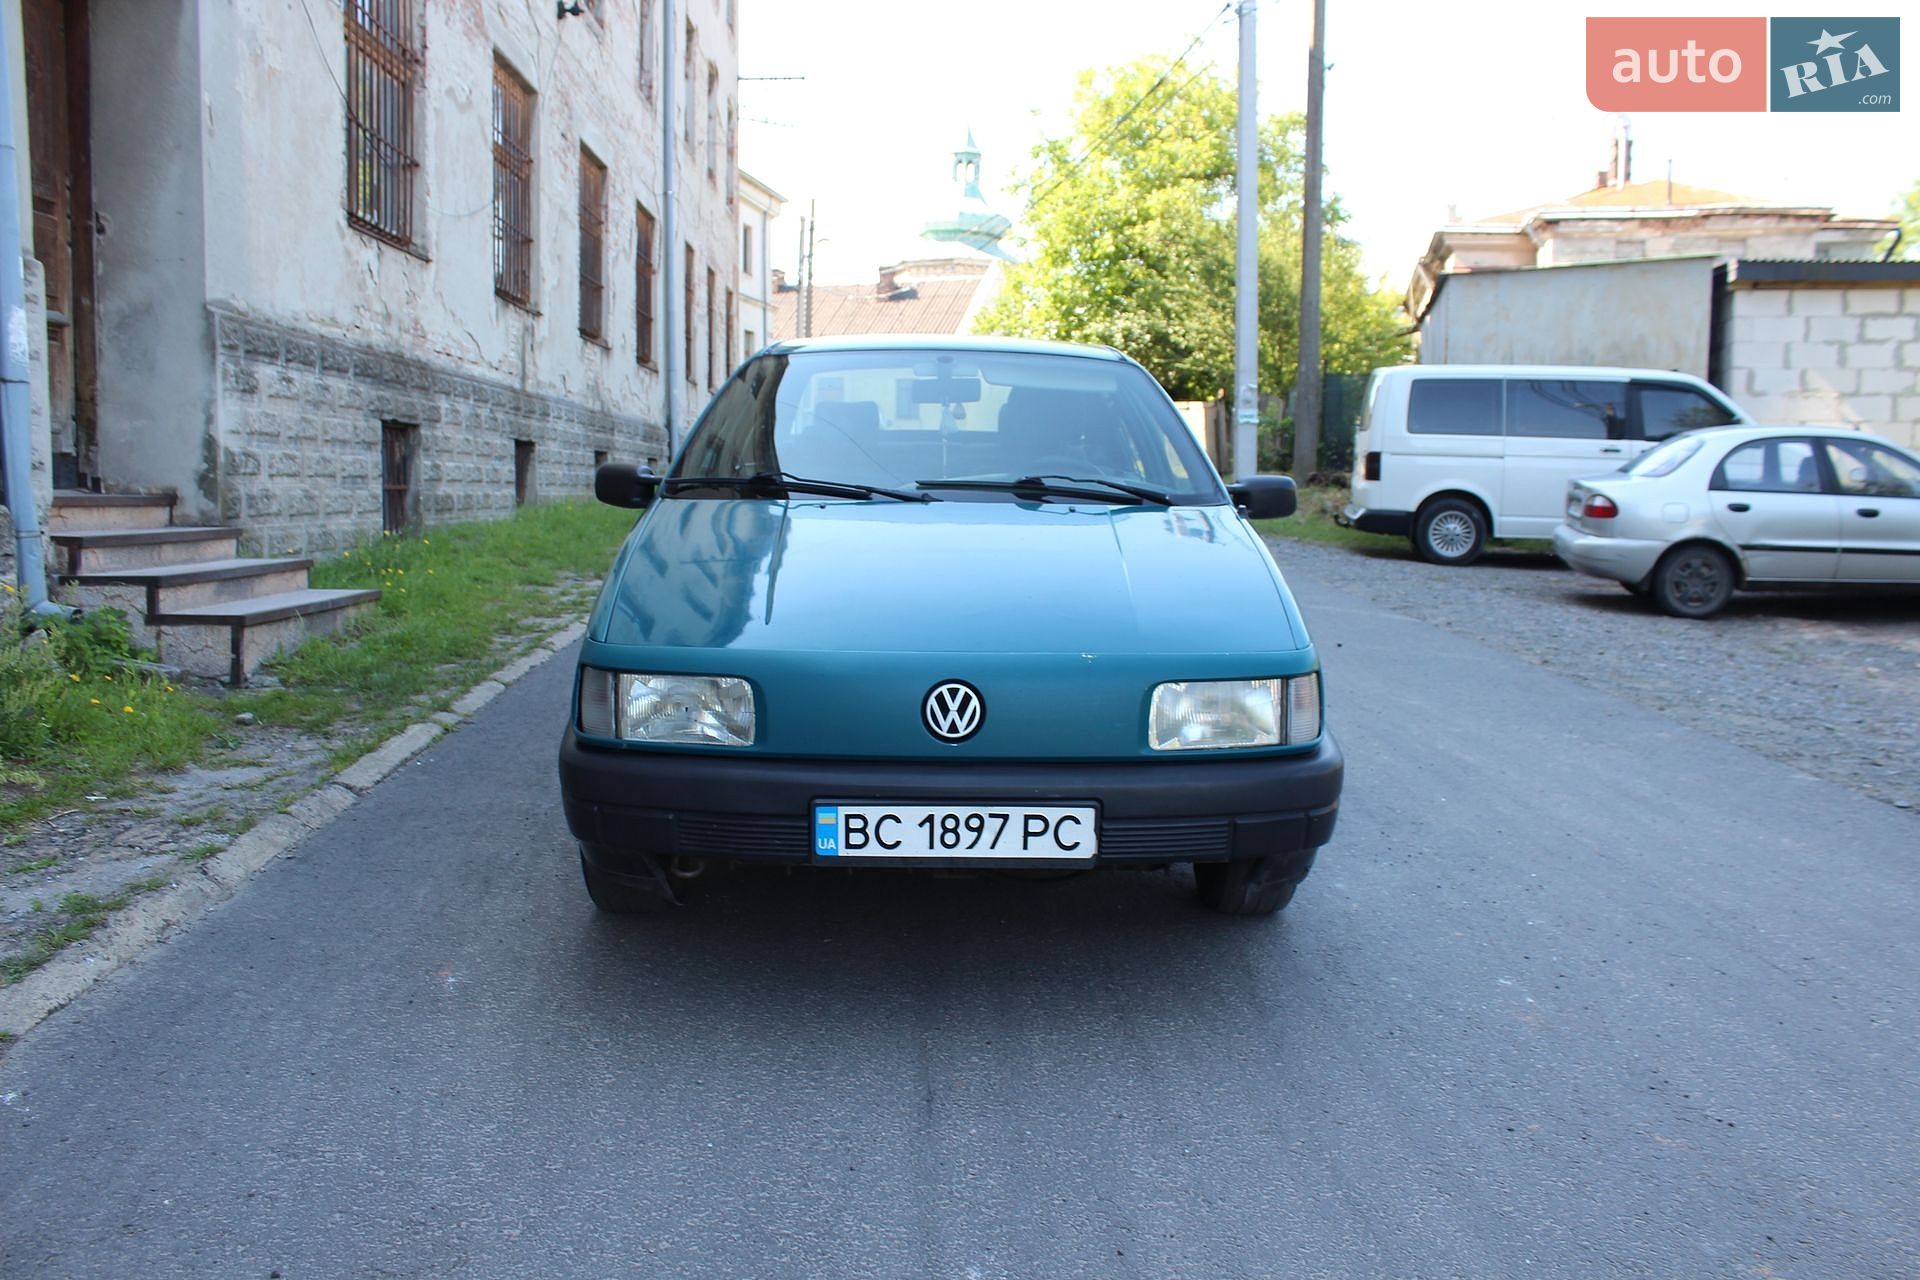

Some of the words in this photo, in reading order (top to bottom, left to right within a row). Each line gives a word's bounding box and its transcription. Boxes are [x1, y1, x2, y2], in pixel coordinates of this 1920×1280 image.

[818, 838, 837, 849] UA
[844, 813, 902, 850] BC
[918, 812, 1010, 850] 1897
[1023, 813, 1082, 851] PC
